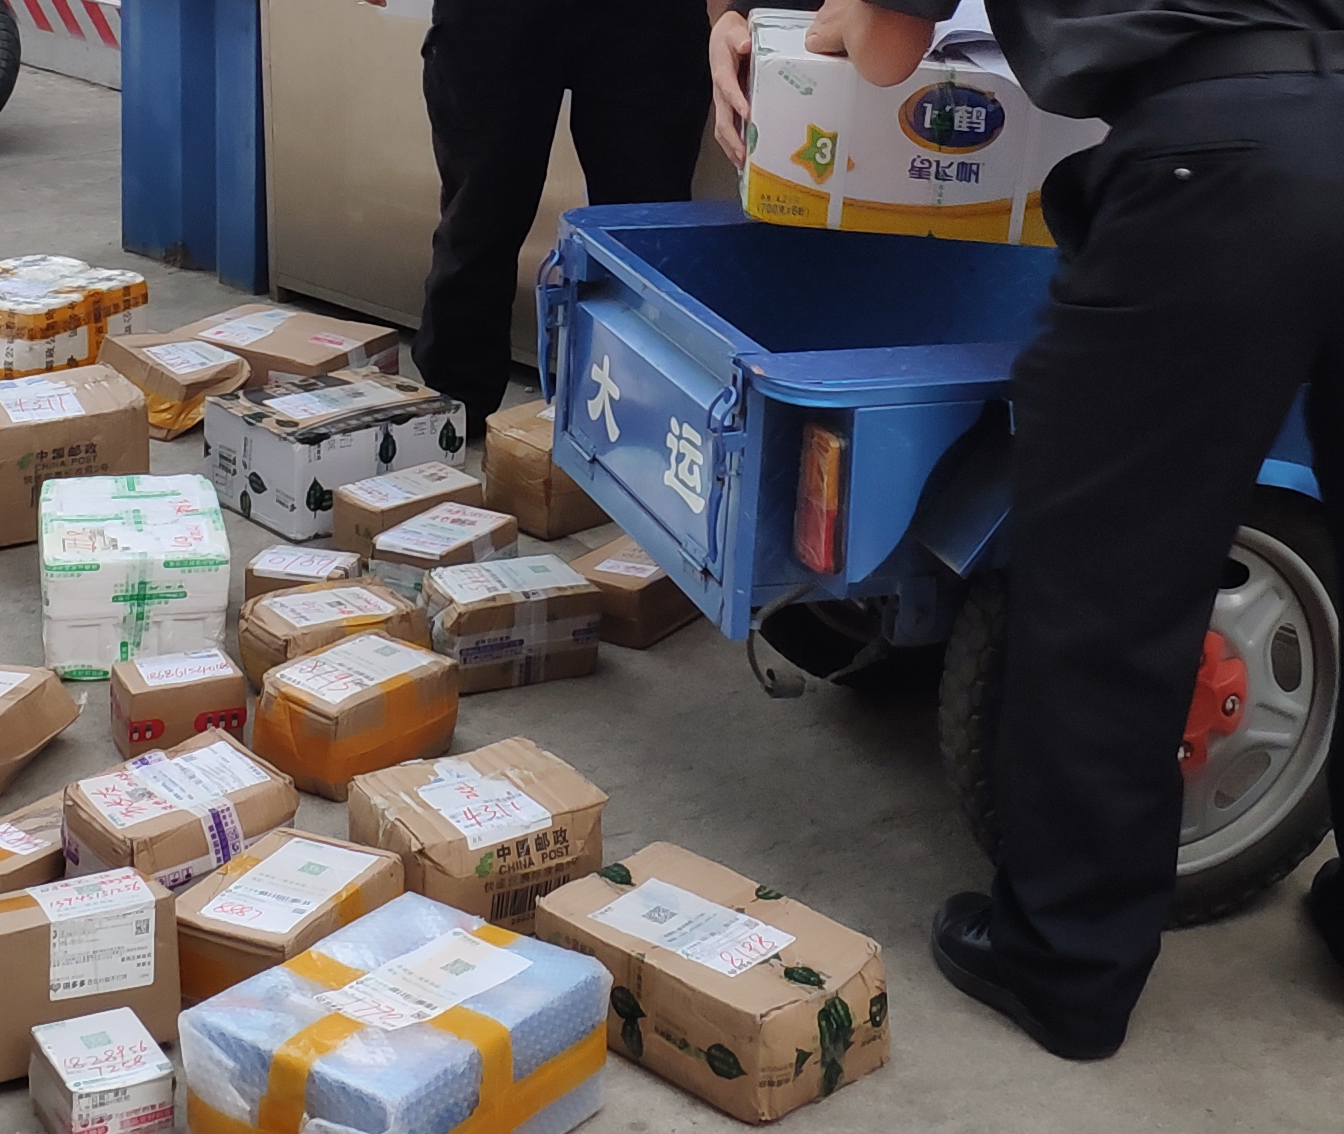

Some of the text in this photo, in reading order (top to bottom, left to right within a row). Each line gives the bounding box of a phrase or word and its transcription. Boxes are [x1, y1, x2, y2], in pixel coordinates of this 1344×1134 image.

[815, 137, 833, 165] 3
[587, 354, 705, 514] 大运
[70, 454, 97, 466] POST
[463, 801, 522, 828] 4311
[496, 827, 569, 863] 中国邮政
[499, 857, 535, 876] CHINA
[541, 844, 570, 864] POST
